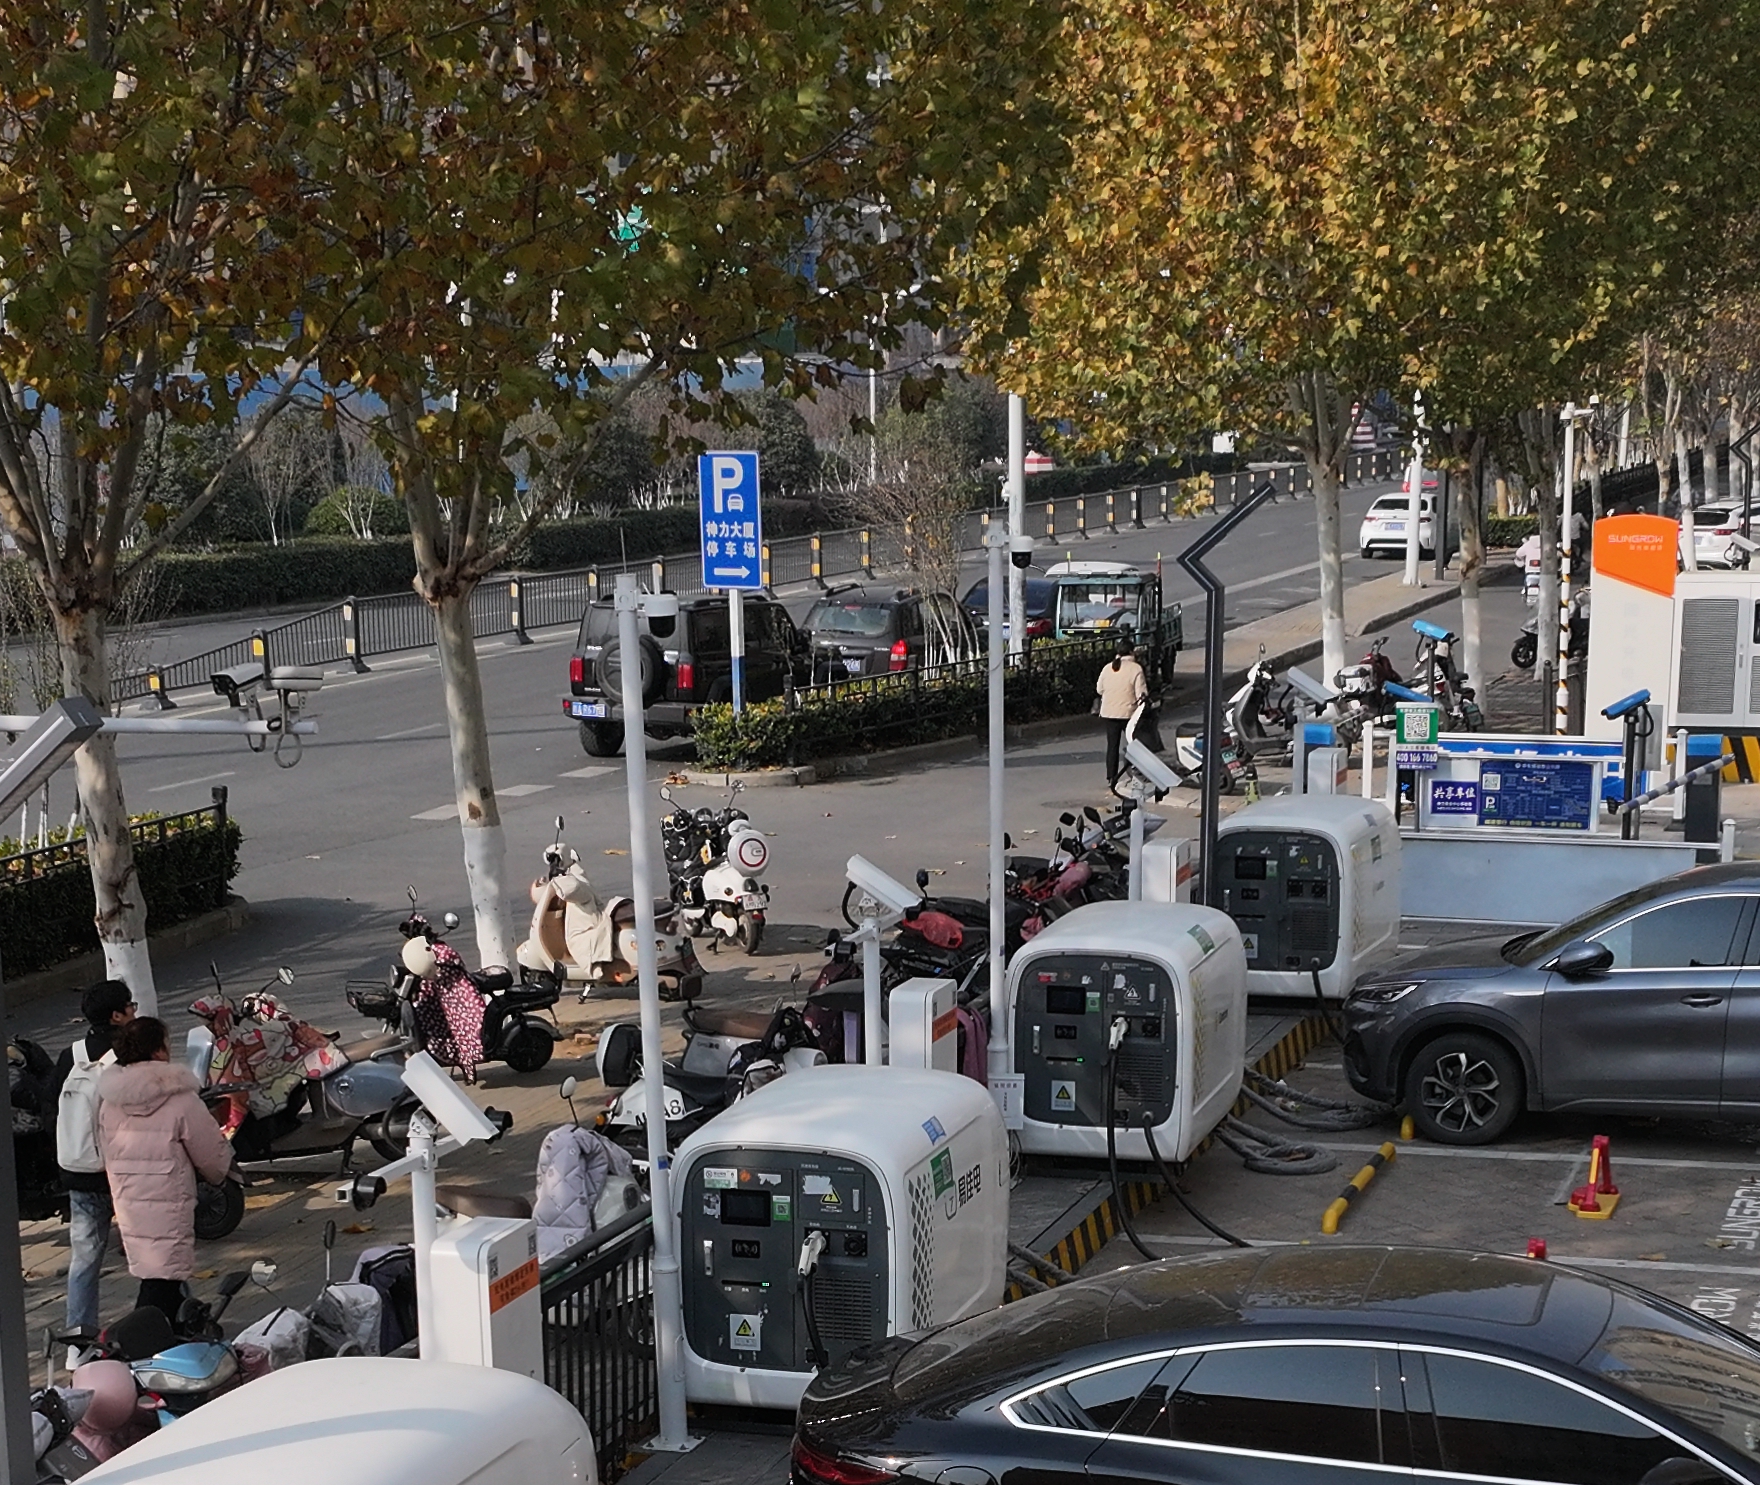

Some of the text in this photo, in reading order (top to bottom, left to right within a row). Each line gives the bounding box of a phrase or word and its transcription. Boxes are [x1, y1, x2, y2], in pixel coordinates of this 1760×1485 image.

[712, 457, 744, 513] P
[705, 521, 755, 538] 神力大厦
[1608, 534, 1664, 543] SUNGROW
[706, 541, 756, 558] 停车场
